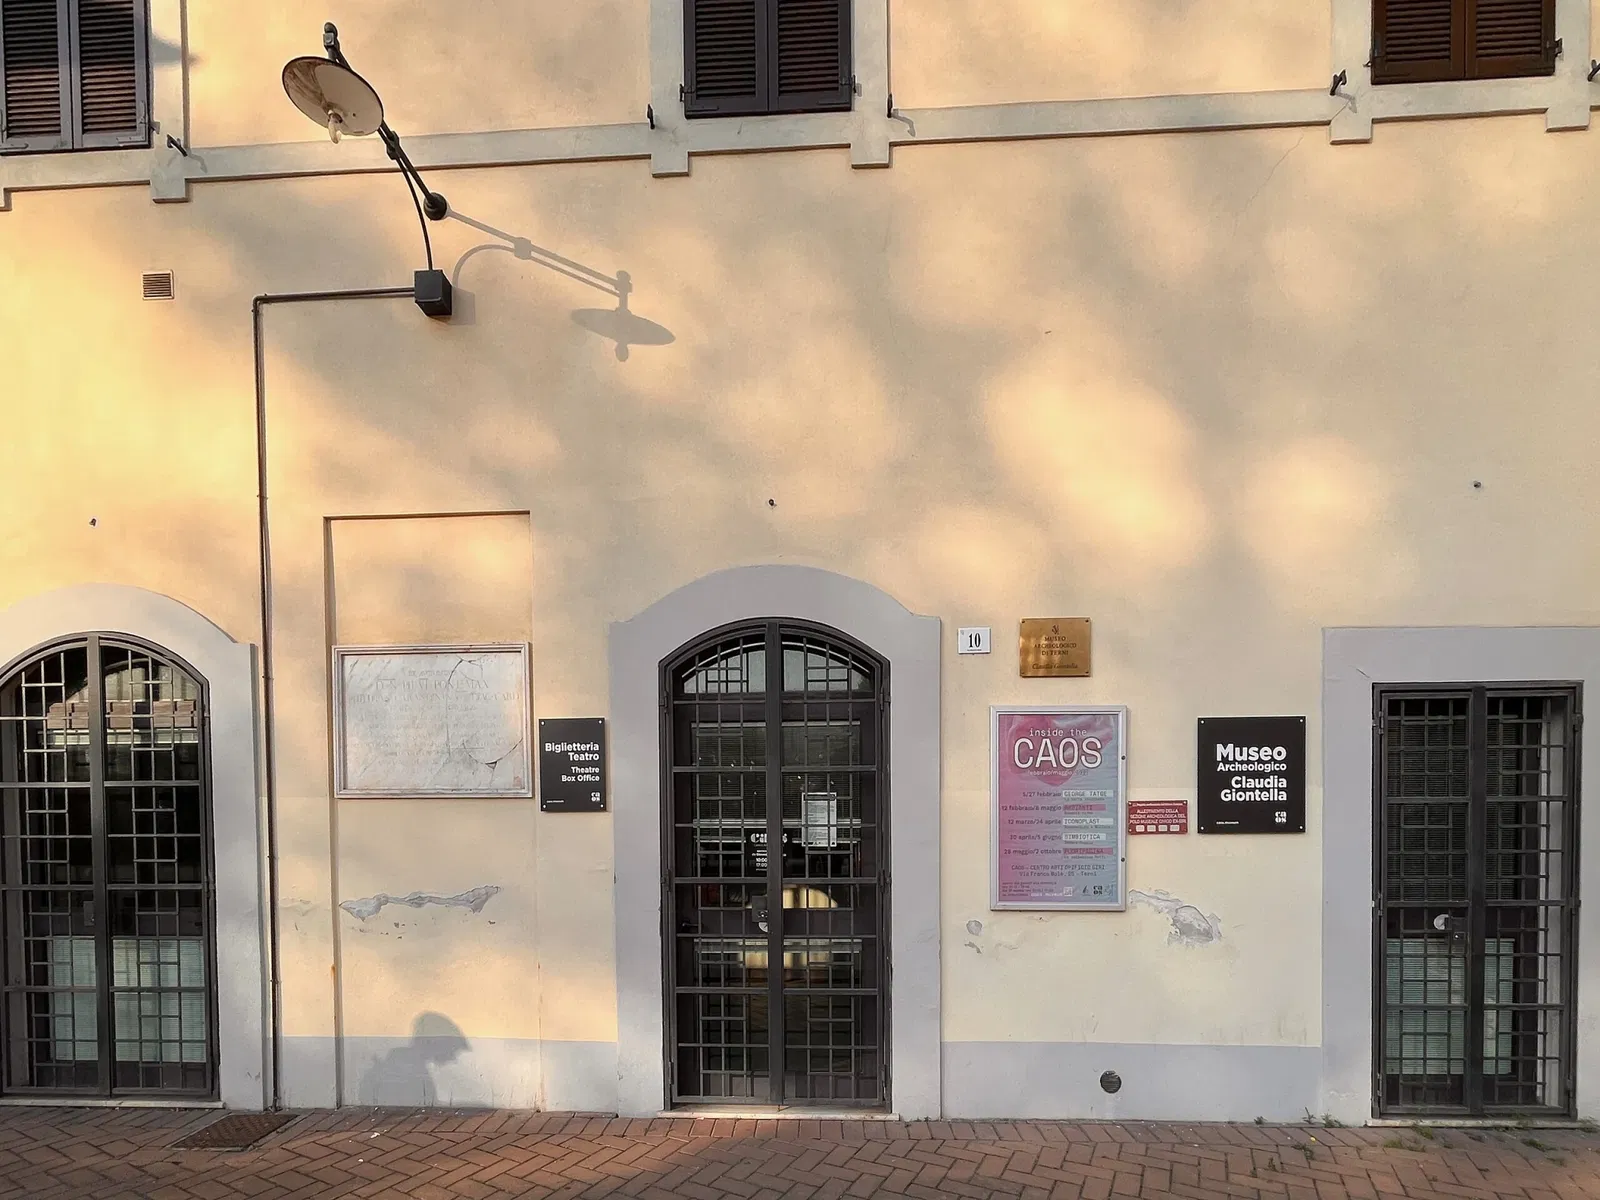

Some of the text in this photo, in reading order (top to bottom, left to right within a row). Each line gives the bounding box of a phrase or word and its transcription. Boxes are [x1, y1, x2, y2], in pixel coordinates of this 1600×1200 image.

[968, 632, 981, 648] 10
[1029, 728, 1087, 736] inside the
[545, 742, 599, 753] Biglietteria
[1014, 737, 1102, 768] CAOS
[1216, 743, 1287, 761] Museo
[568, 752, 600, 761] Teatro
[1217, 761, 1287, 773] Archeologico
[577, 774, 600, 782] Office
[1231, 775, 1287, 789] Claudia
[1220, 788, 1287, 801] Giontella
